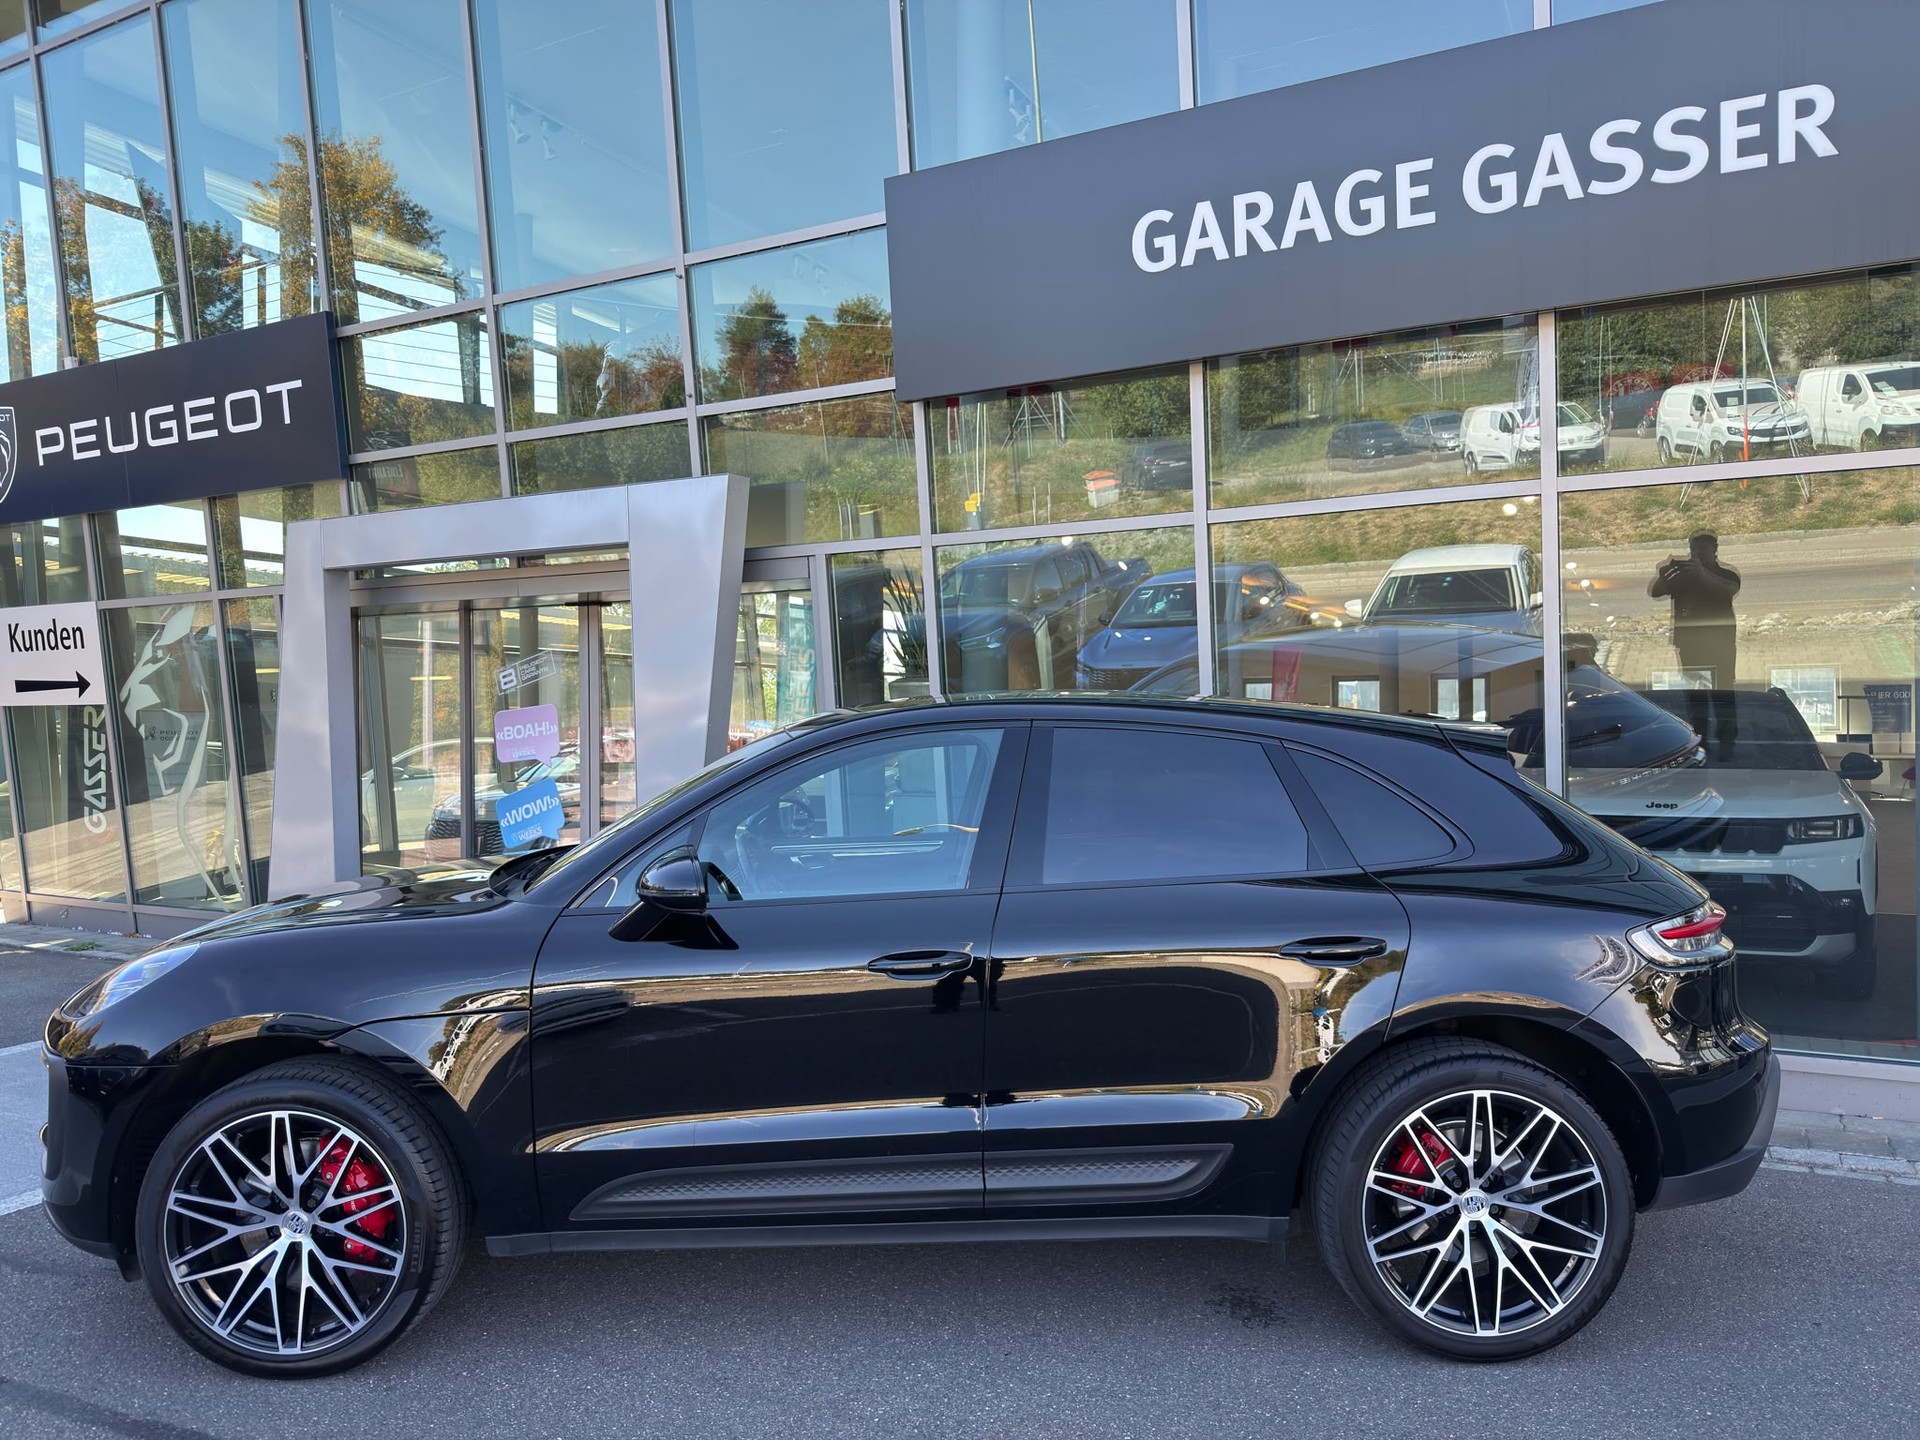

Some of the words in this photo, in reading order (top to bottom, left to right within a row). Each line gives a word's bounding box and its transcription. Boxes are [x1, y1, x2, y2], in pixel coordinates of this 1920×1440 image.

[1131, 158, 1437, 273] GARAGE
[1461, 84, 1839, 215] GASSER
[35, 379, 302, 466] PEUGEOT
[8, 617, 85, 653] Kunden
[496, 721, 559, 741] «BOAH!»
[83, 706, 107, 834] GASSER
[501, 795, 559, 828] «WOW!»
[1645, 802, 1678, 810] Jeep
